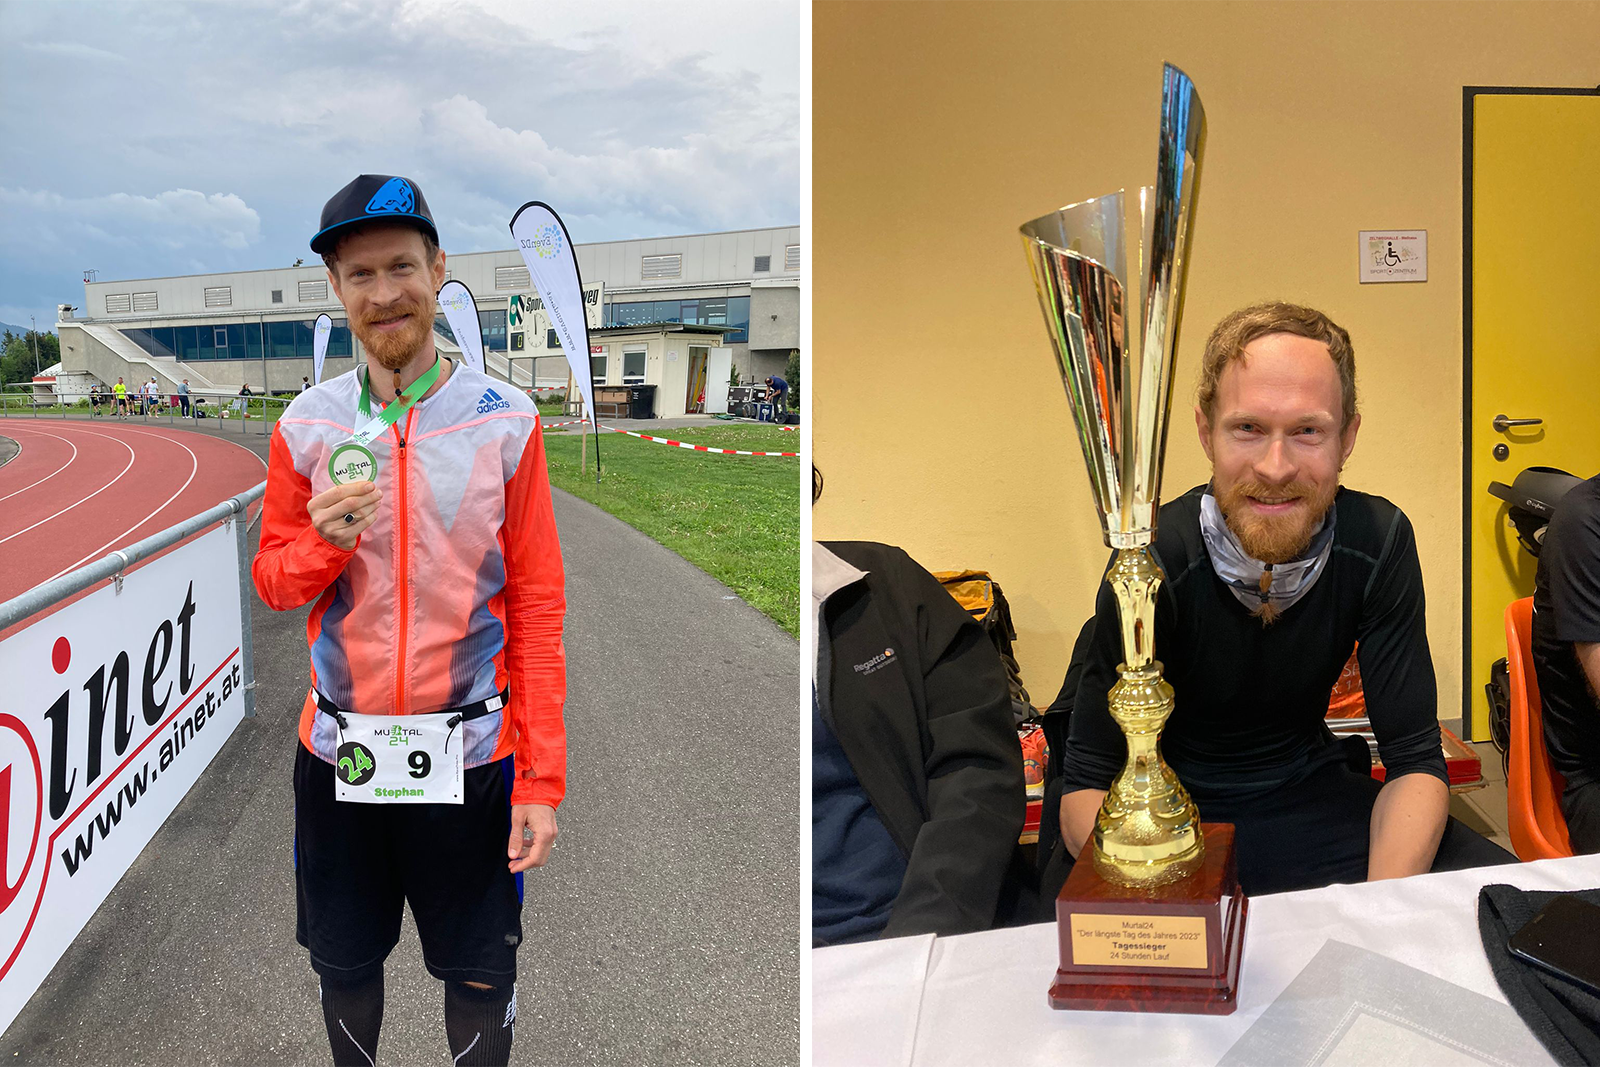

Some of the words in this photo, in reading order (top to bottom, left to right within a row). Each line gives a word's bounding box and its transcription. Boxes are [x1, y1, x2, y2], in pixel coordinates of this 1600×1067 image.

[476, 401, 511, 414] adidas
[348, 469, 364, 480] 24
[853, 653, 886, 672] Regatta
[389, 736, 409, 747] 24
[61, 663, 240, 877] www.ainet.at
[338, 746, 374, 783] 24
[407, 750, 432, 779] 9
[374, 787, 424, 799] Stephan
[1122, 922, 1154, 930] Murtal24
[1095, 930, 1121, 940] längste
[1122, 931, 1136, 940] Tag
[1138, 931, 1151, 939] des
[1153, 932, 1177, 940] Jahres
[1112, 942, 1167, 952] Tagessieger
[1110, 952, 1119, 960] 24
[1121, 952, 1152, 960] Stunden
